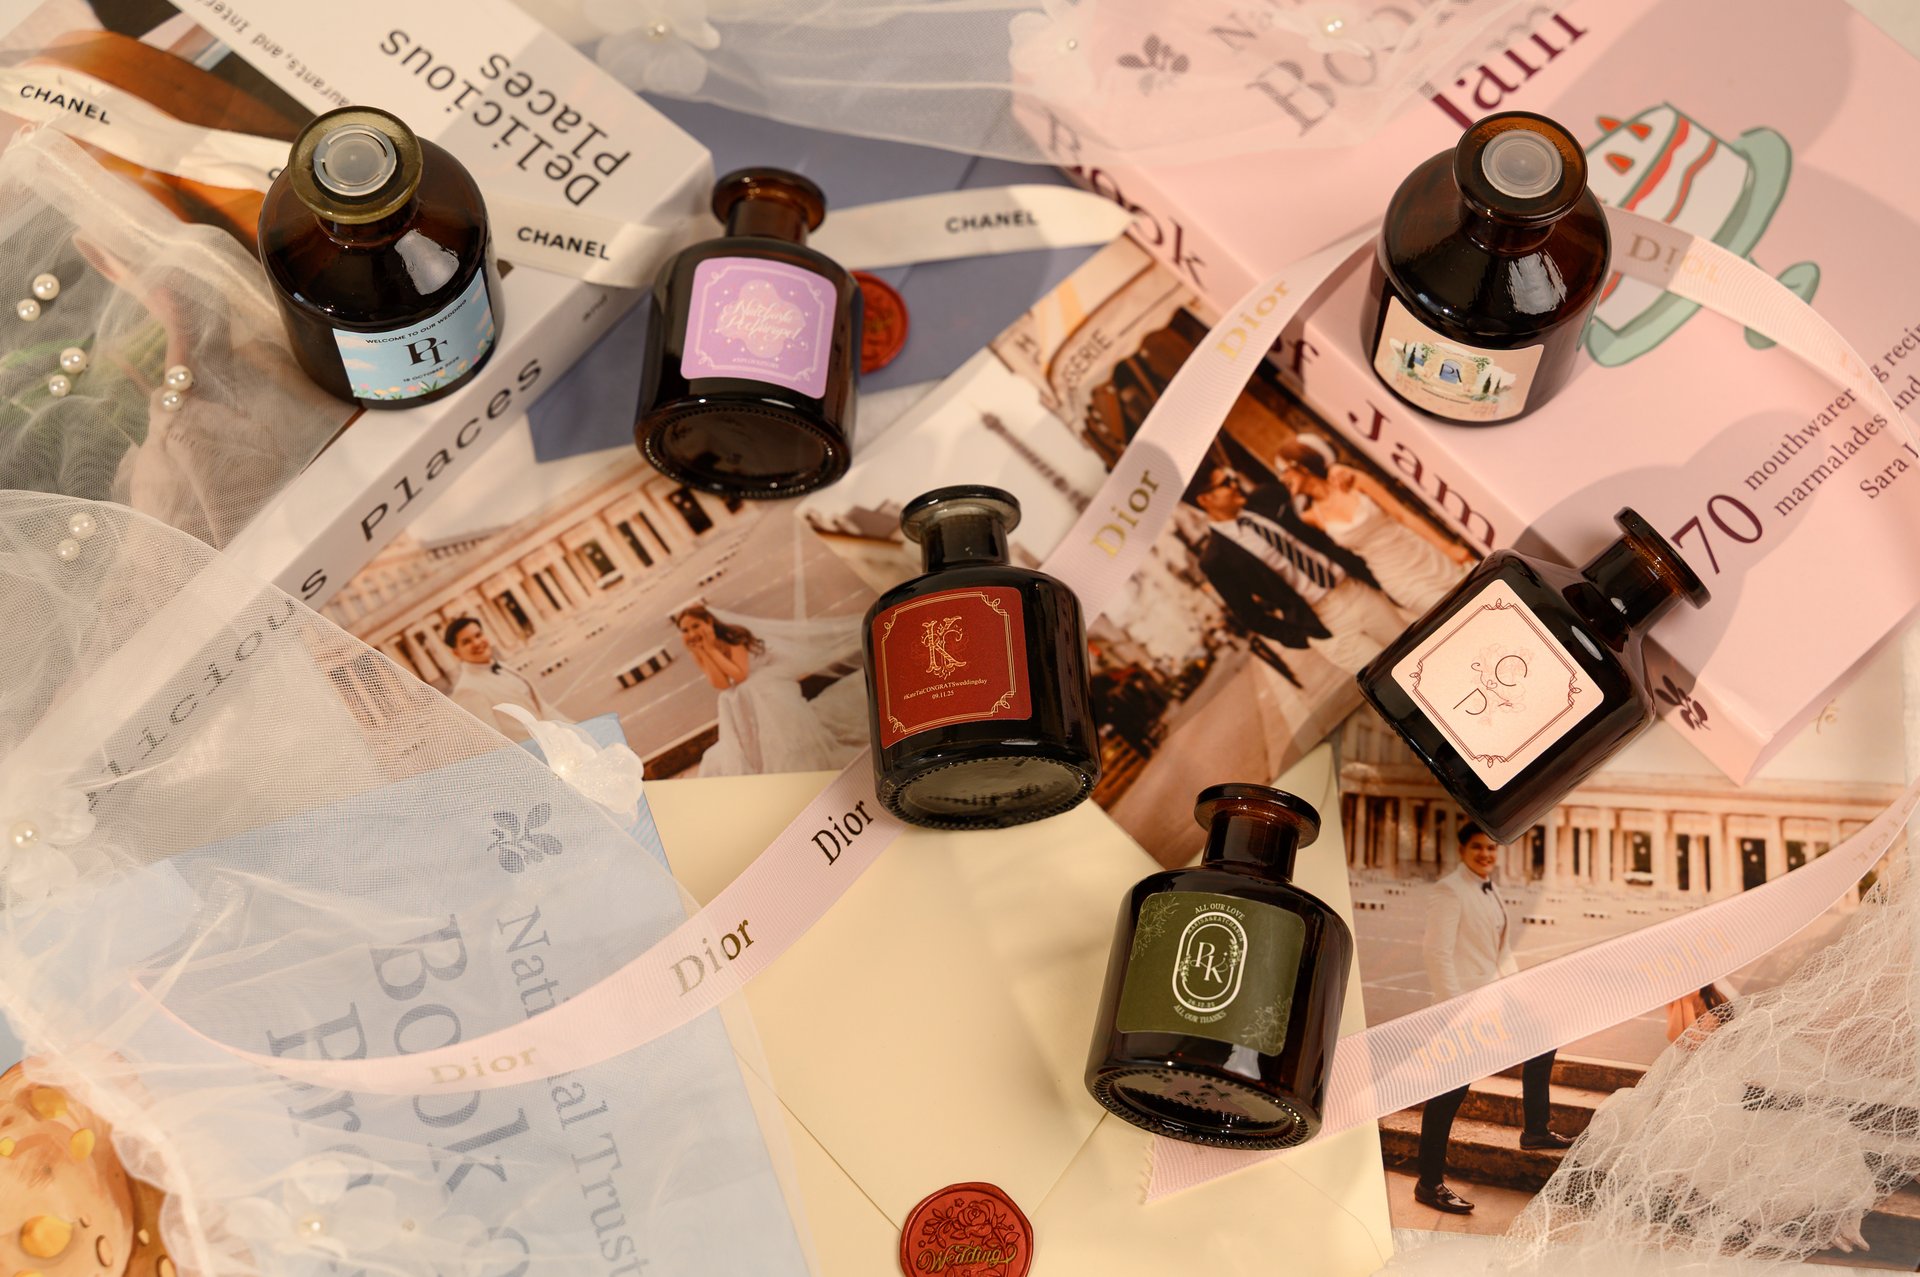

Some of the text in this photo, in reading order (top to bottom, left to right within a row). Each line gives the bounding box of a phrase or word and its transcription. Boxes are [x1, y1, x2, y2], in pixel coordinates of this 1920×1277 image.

[20, 84, 111, 125] CHANEL
[380, 29, 601, 206] Delicious
[480, 53, 631, 176] Places
[516, 226, 611, 262] CHANEL
[946, 208, 1039, 234] CHANEL
[1217, 280, 1290, 362] Dior
[360, 358, 542, 542] Places
[1347, 399, 1496, 549] Jam
[1774, 413, 1888, 517] marmalades
[1858, 454, 1909, 499] Sara
[1089, 469, 1159, 560] Dior
[1670, 494, 1764, 574] 70
[811, 800, 874, 866] Dior
[1195, 902, 1246, 921] ALL OUR LOVE
[669, 919, 755, 998] Dior
[496, 904, 609, 1132] Natial
[430, 1046, 537, 1085] Dior
[916, 1243, 1019, 1275] Wedding
